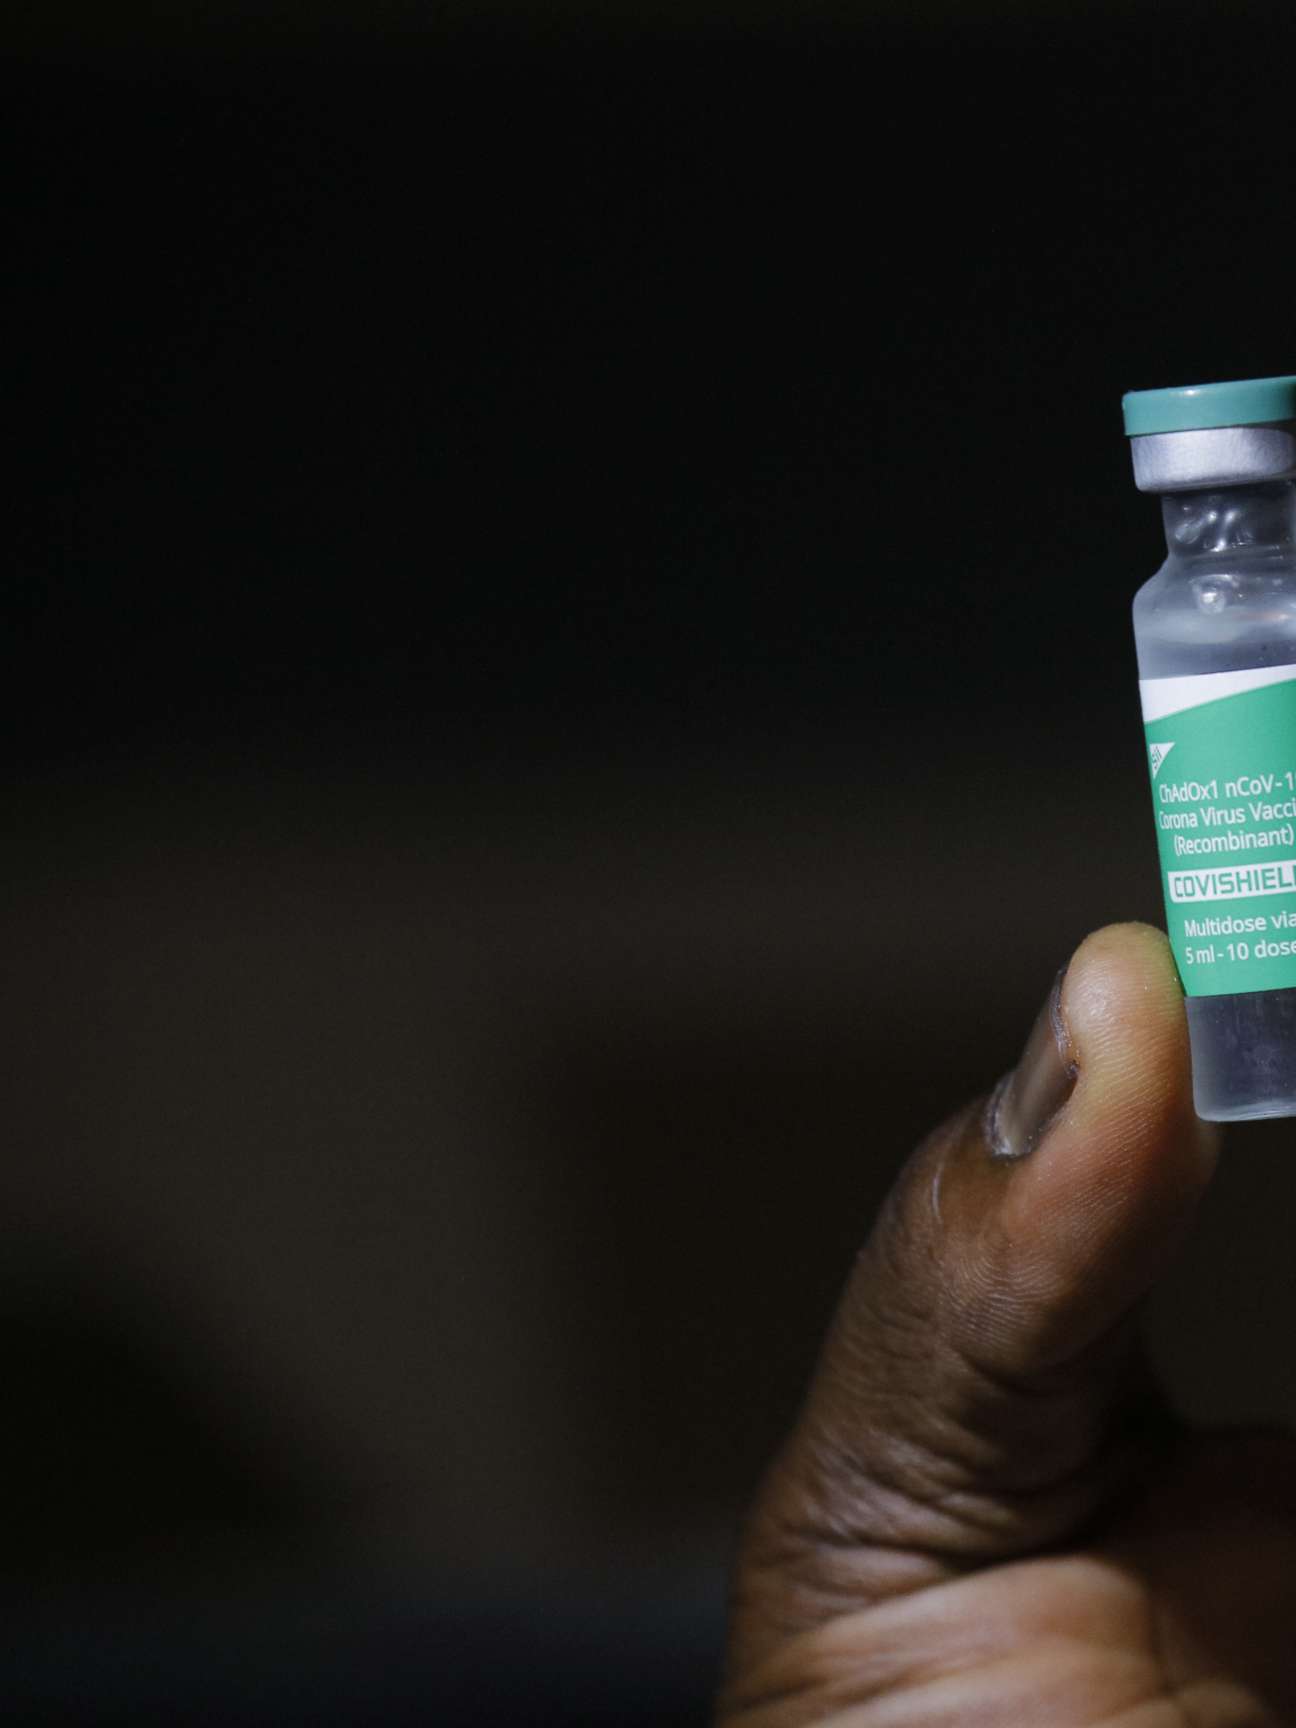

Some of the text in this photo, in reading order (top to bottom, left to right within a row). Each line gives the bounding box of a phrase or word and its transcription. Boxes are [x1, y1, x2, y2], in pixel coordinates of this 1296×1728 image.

[1159, 780, 1218, 803] ChAdOx1
[1160, 811, 1198, 830] Corona
[1200, 806, 1245, 827] Virus
[1174, 824, 1294, 856] (Recombinant)
[1184, 915, 1267, 937] Multidose
[1186, 947, 1193, 965] 5
